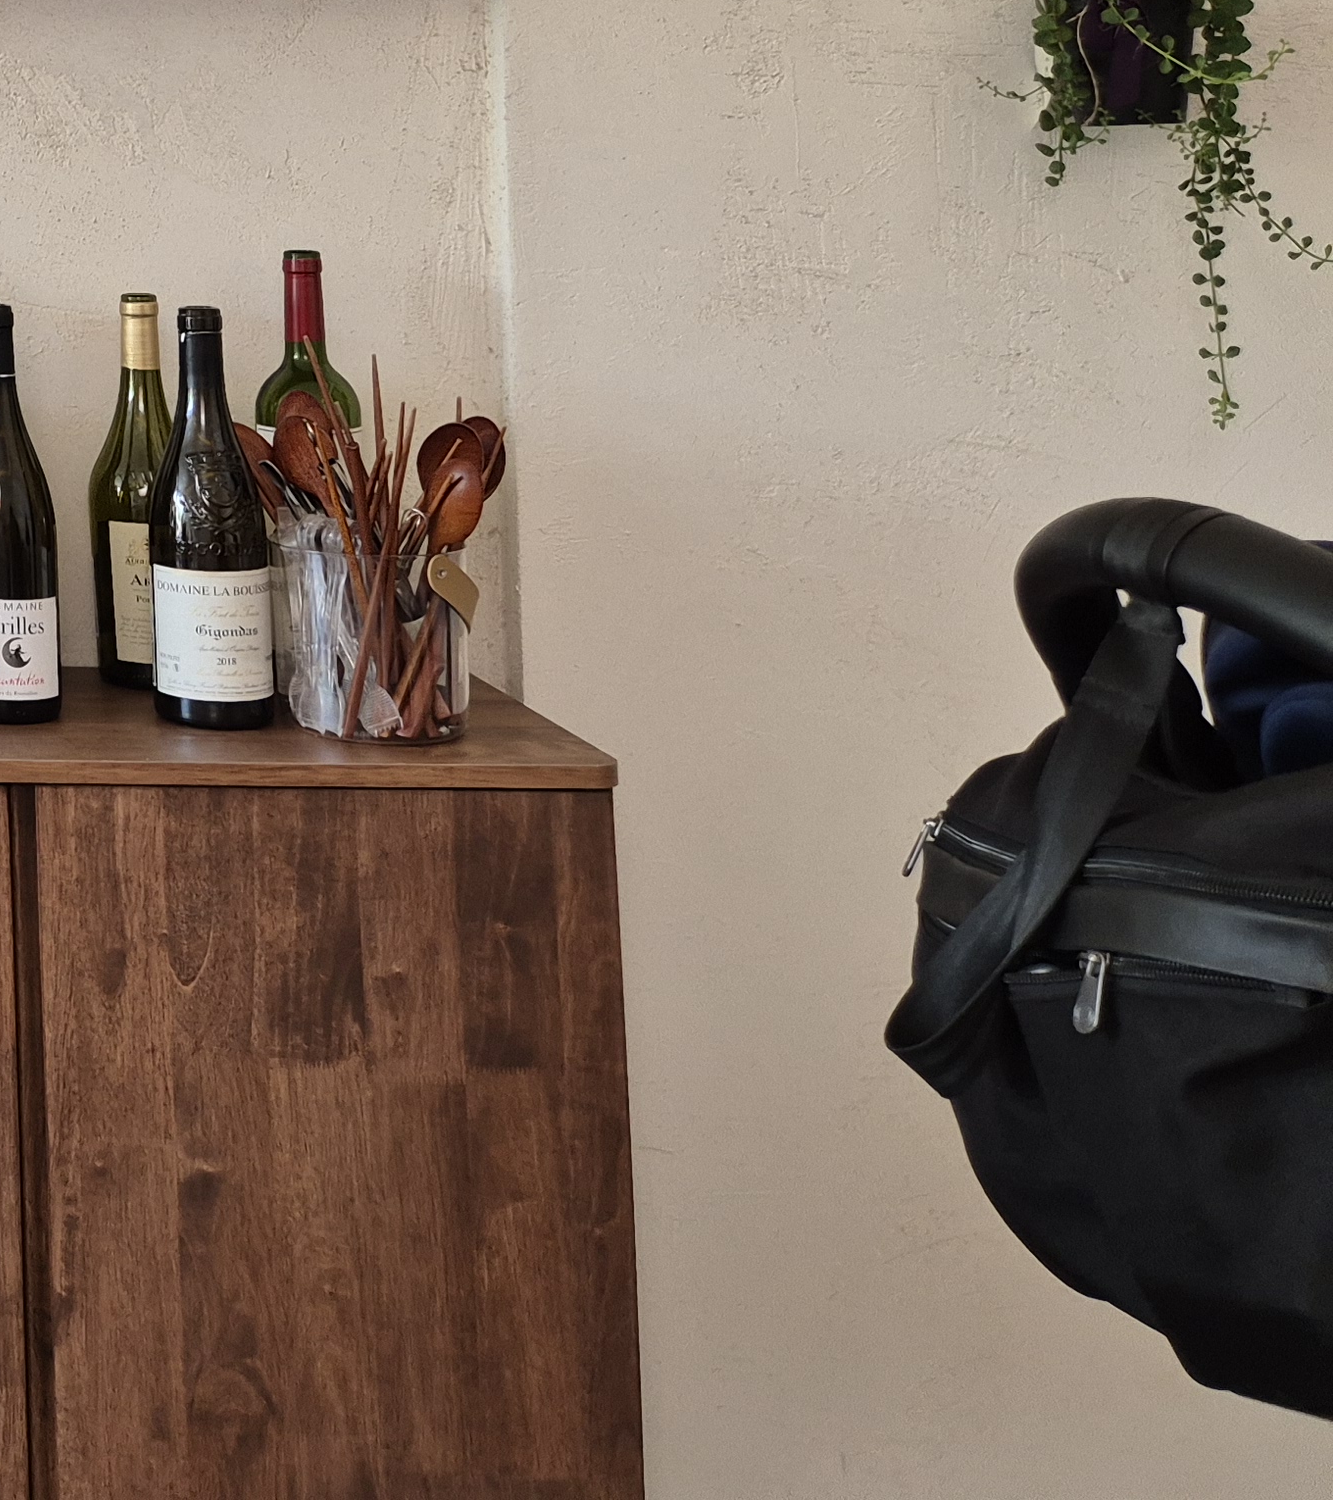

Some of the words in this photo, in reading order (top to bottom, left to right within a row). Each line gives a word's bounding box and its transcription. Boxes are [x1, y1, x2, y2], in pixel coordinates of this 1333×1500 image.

[156, 580, 210, 596] DOMAINE
[213, 586, 231, 596] LA
[195, 624, 259, 640] Gigondas
[216, 657, 237, 666] 2018
